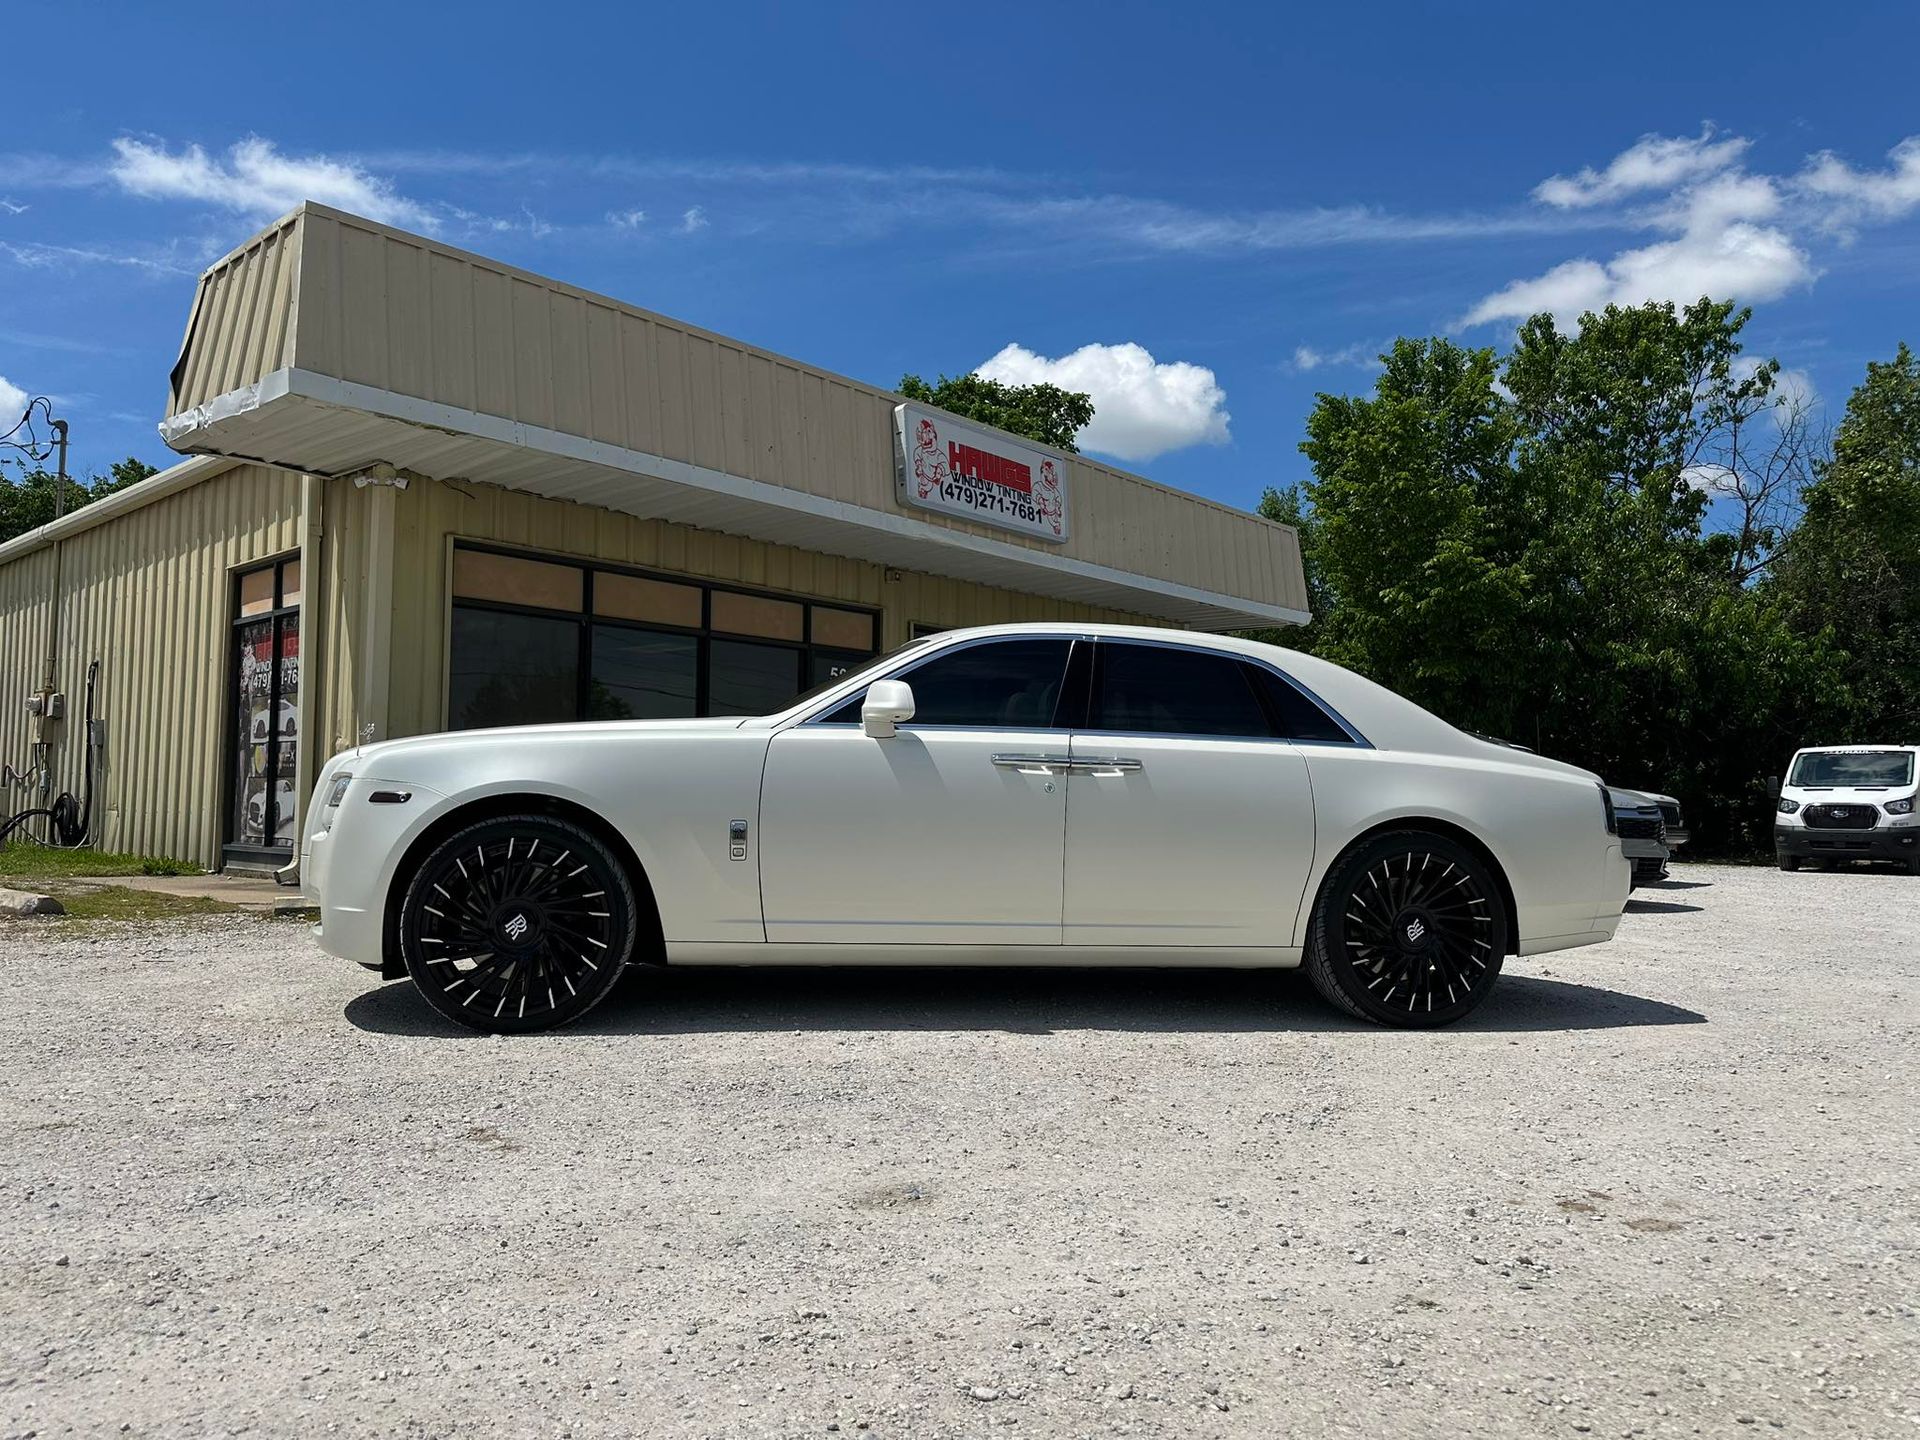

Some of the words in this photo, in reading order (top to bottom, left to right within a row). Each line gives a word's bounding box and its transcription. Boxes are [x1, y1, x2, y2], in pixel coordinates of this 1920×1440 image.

[949, 440, 1032, 494] HAWGS
[950, 471, 994, 493] WINDOW
[996, 484, 1032, 505] TINTING
[939, 480, 1043, 524] (479)271-7681
